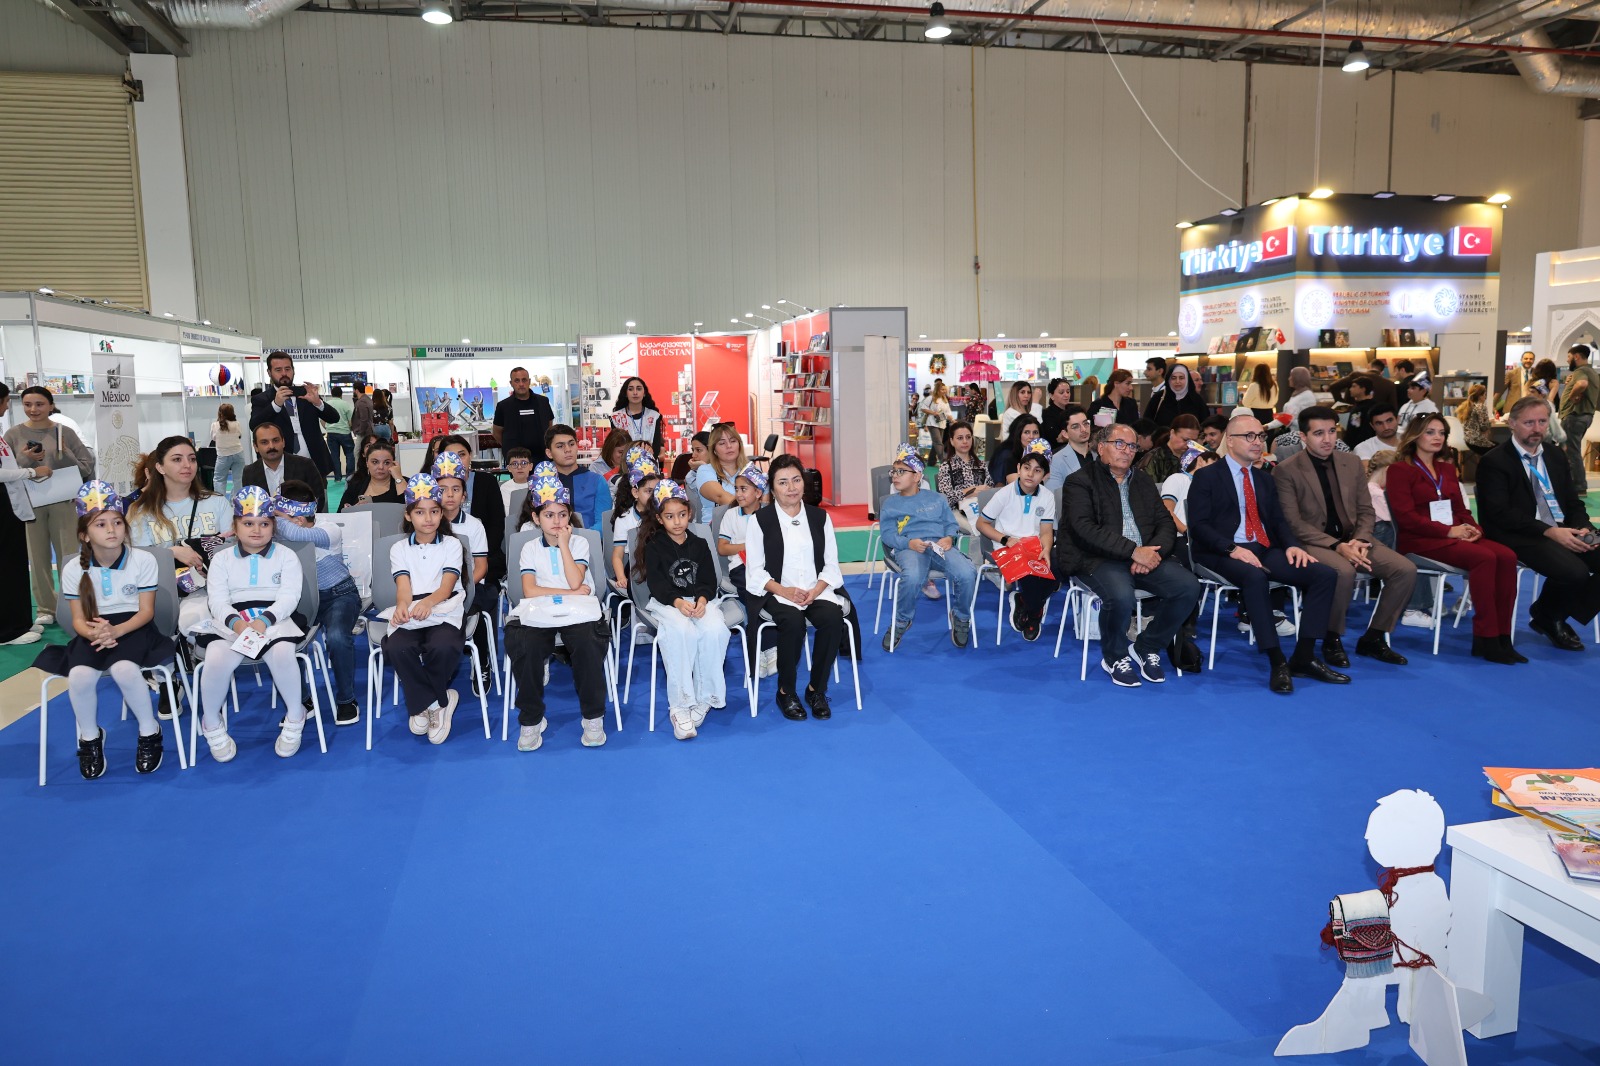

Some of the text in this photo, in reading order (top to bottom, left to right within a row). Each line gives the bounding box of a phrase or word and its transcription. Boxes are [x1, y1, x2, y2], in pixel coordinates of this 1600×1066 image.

[1306, 225, 1445, 262] Türkiye
[1180, 240, 1264, 276] Türkiye
[102, 391, 130, 402] México
[436, 452, 460, 464] STARS
[409, 474, 435, 488] STARS
[535, 476, 560, 490] STARS
[79, 482, 111, 497] STARS
[238, 486, 267, 500] STARS
[277, 500, 311, 513] CAMPUS
